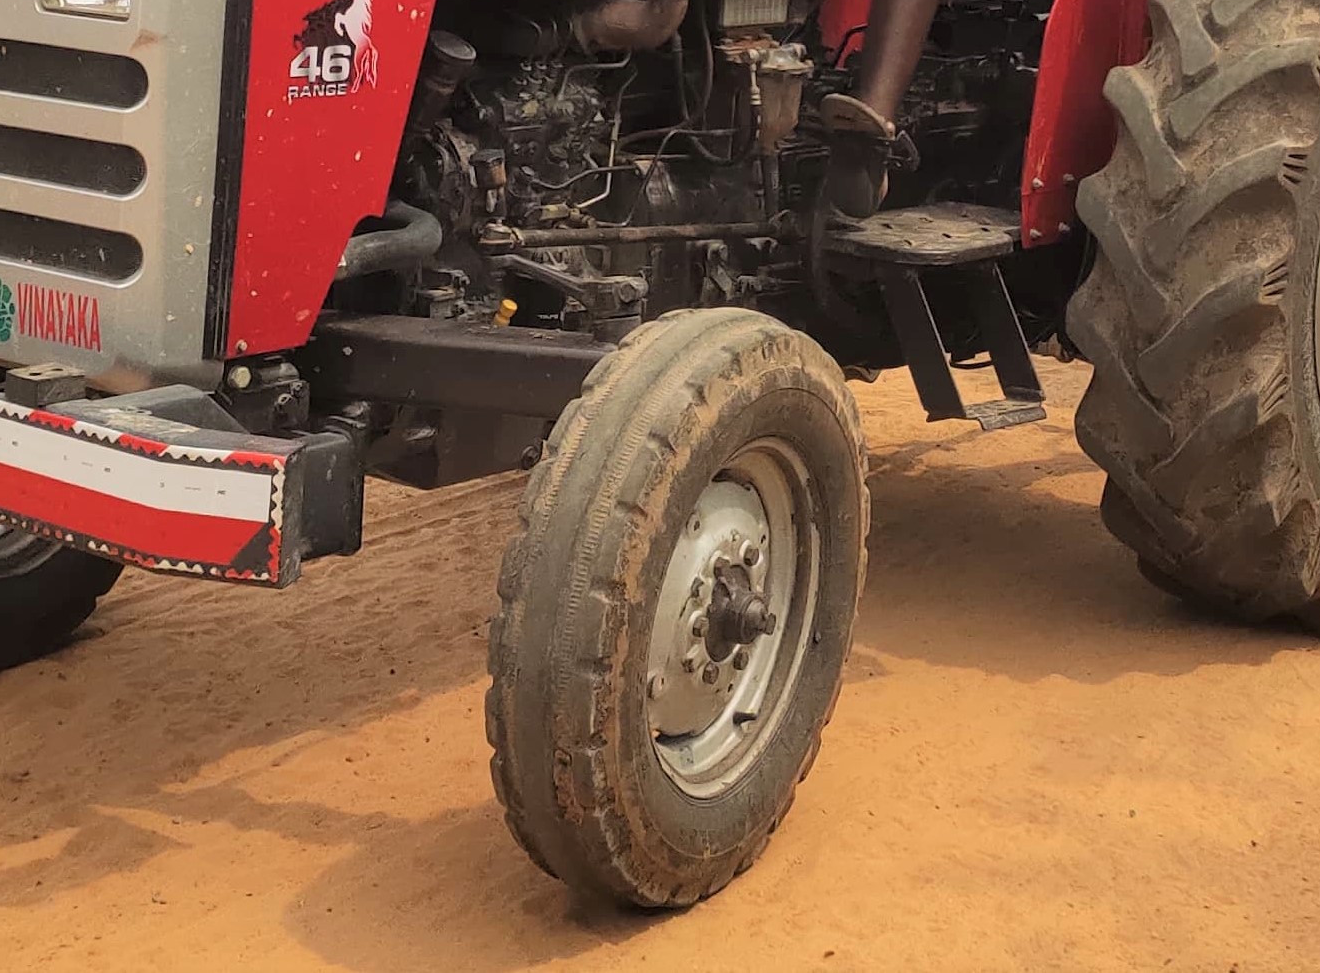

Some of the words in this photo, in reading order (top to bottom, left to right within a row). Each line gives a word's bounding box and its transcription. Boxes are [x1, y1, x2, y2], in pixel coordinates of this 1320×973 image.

[289, 44, 352, 83] 46
[287, 83, 348, 99] RANGE
[17, 281, 102, 353] VINAYAKA
